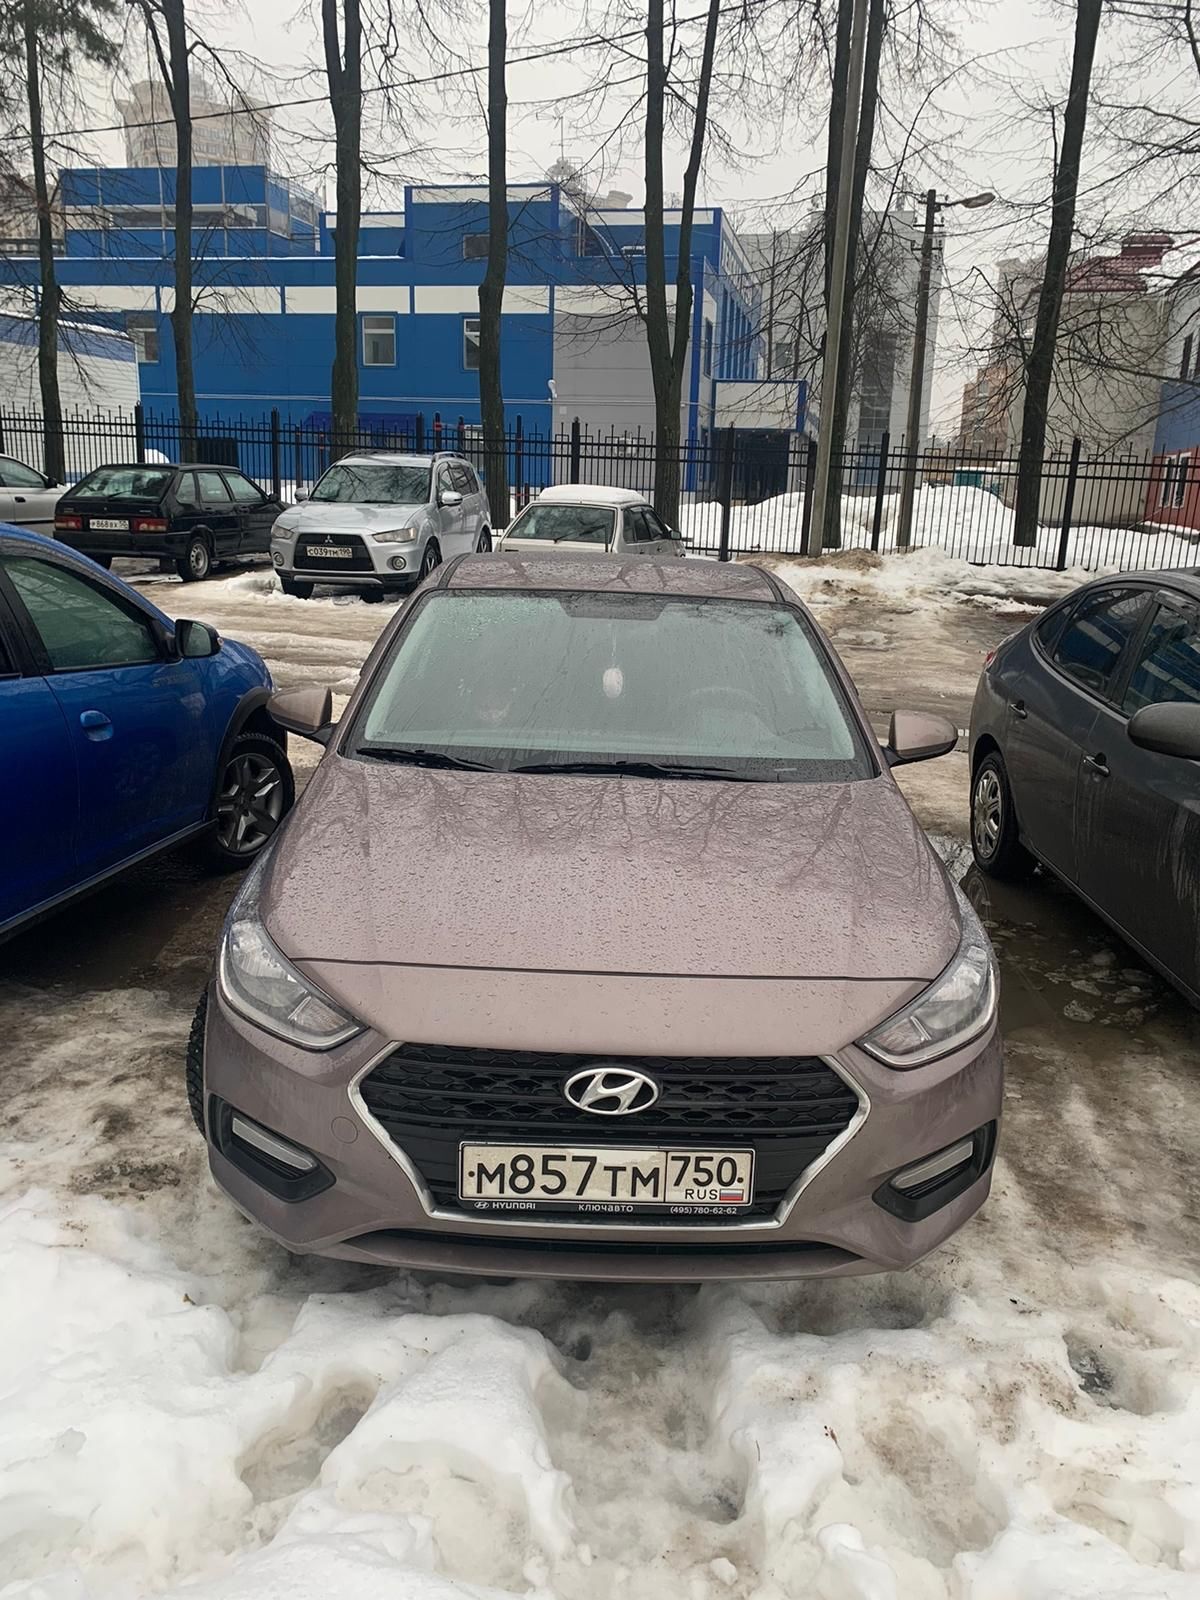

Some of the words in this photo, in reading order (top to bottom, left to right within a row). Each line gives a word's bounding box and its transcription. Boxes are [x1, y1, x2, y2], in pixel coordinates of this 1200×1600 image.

[670, 1155, 738, 1187] 750
[685, 1188, 718, 1200] RUS
[492, 1201, 536, 1209] HYUNDAI
